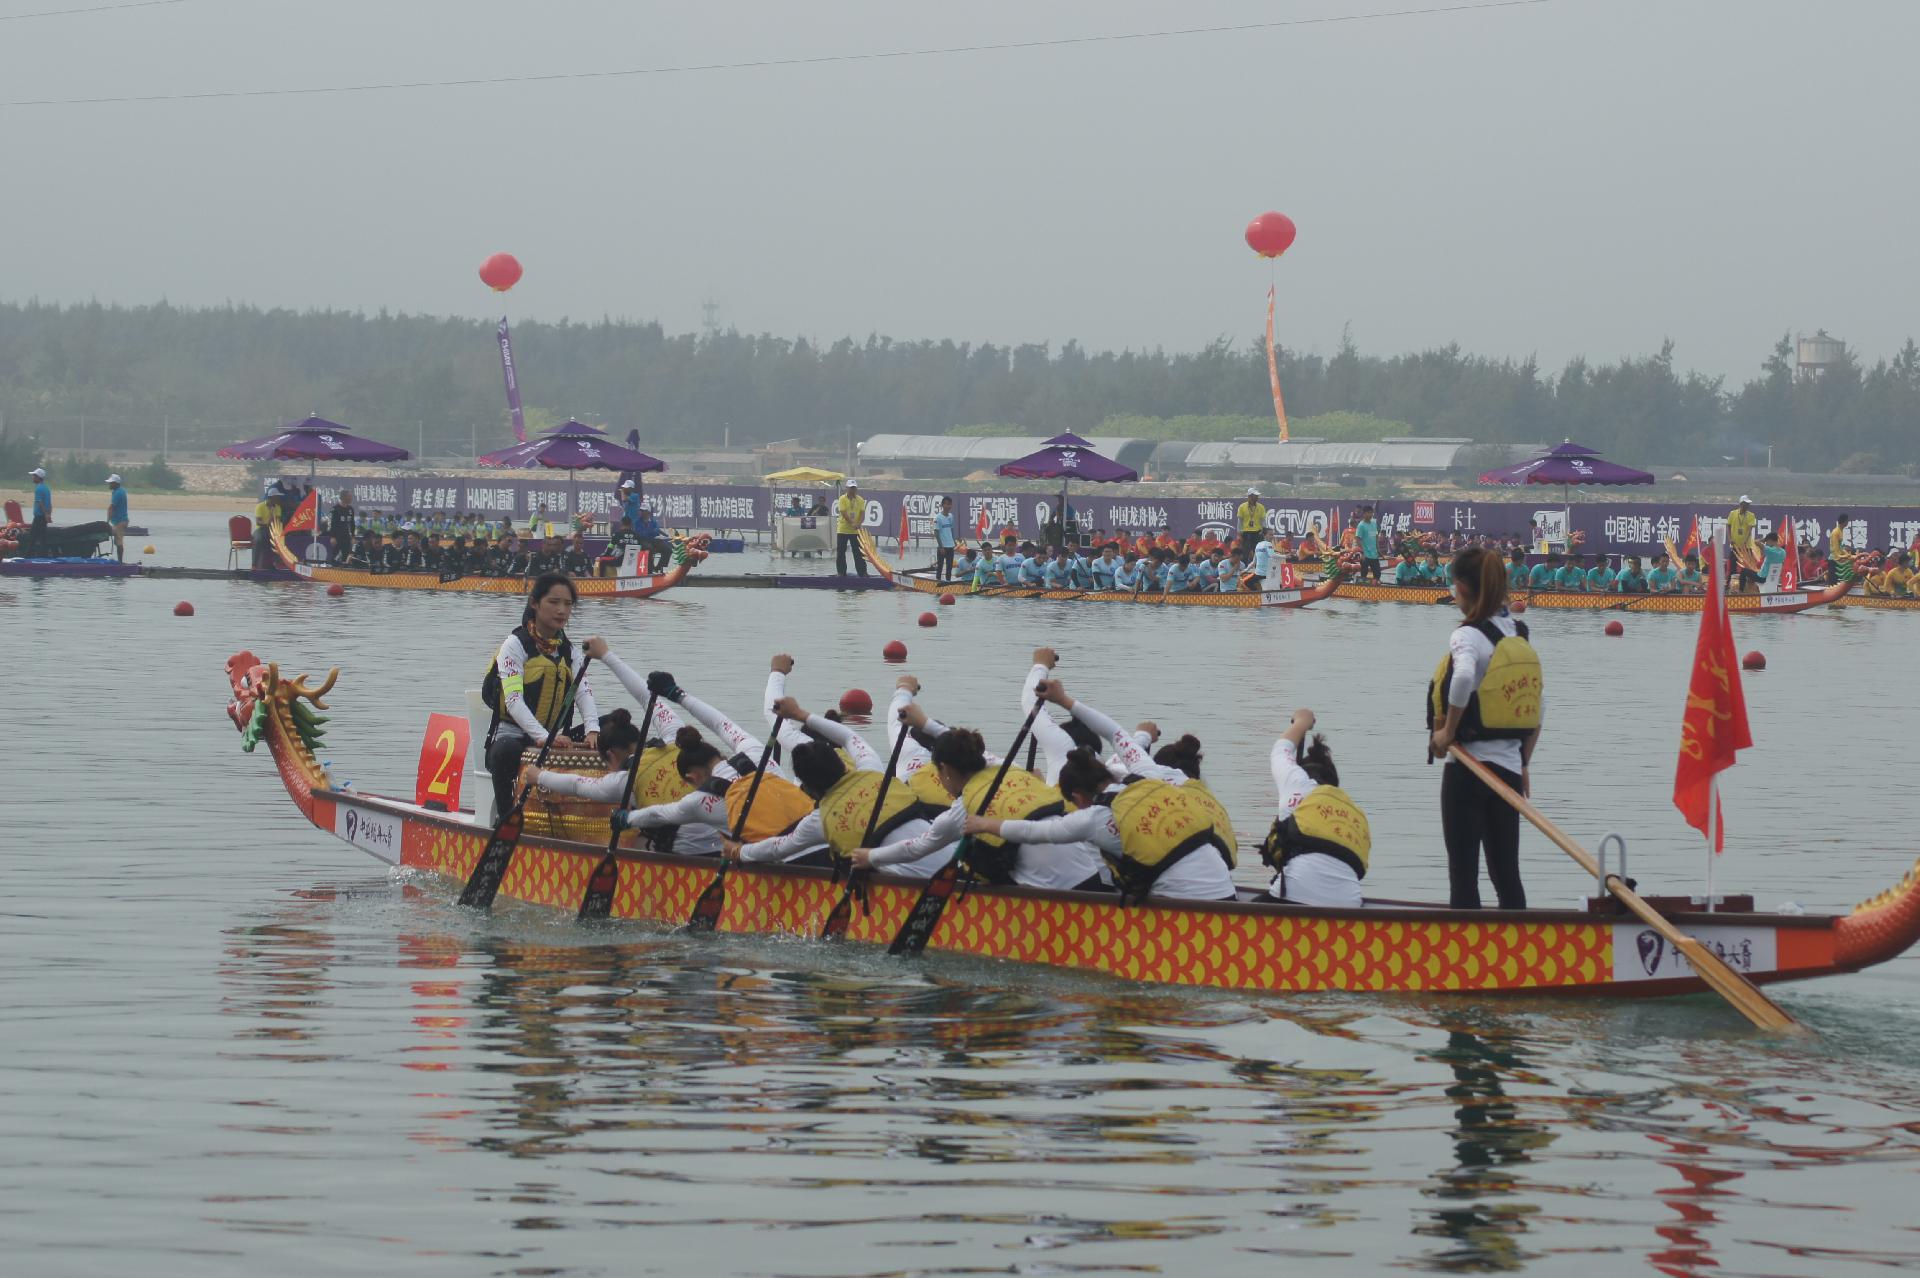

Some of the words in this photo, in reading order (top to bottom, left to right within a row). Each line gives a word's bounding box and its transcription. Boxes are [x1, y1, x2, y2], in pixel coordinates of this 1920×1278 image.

[354, 484, 398, 503] 中国龙舟协会
[411, 487, 457, 509] 培生船艇
[700, 497, 754, 519] 努力办好自贸区
[1109, 505, 1167, 527] 中国龙舟协会
[1198, 501, 1233, 520] 中视体育
[639, 553, 646, 573] 4
[1284, 566, 1291, 585] 3
[1785, 571, 1793, 590] 2
[428, 729, 456, 794] 2
